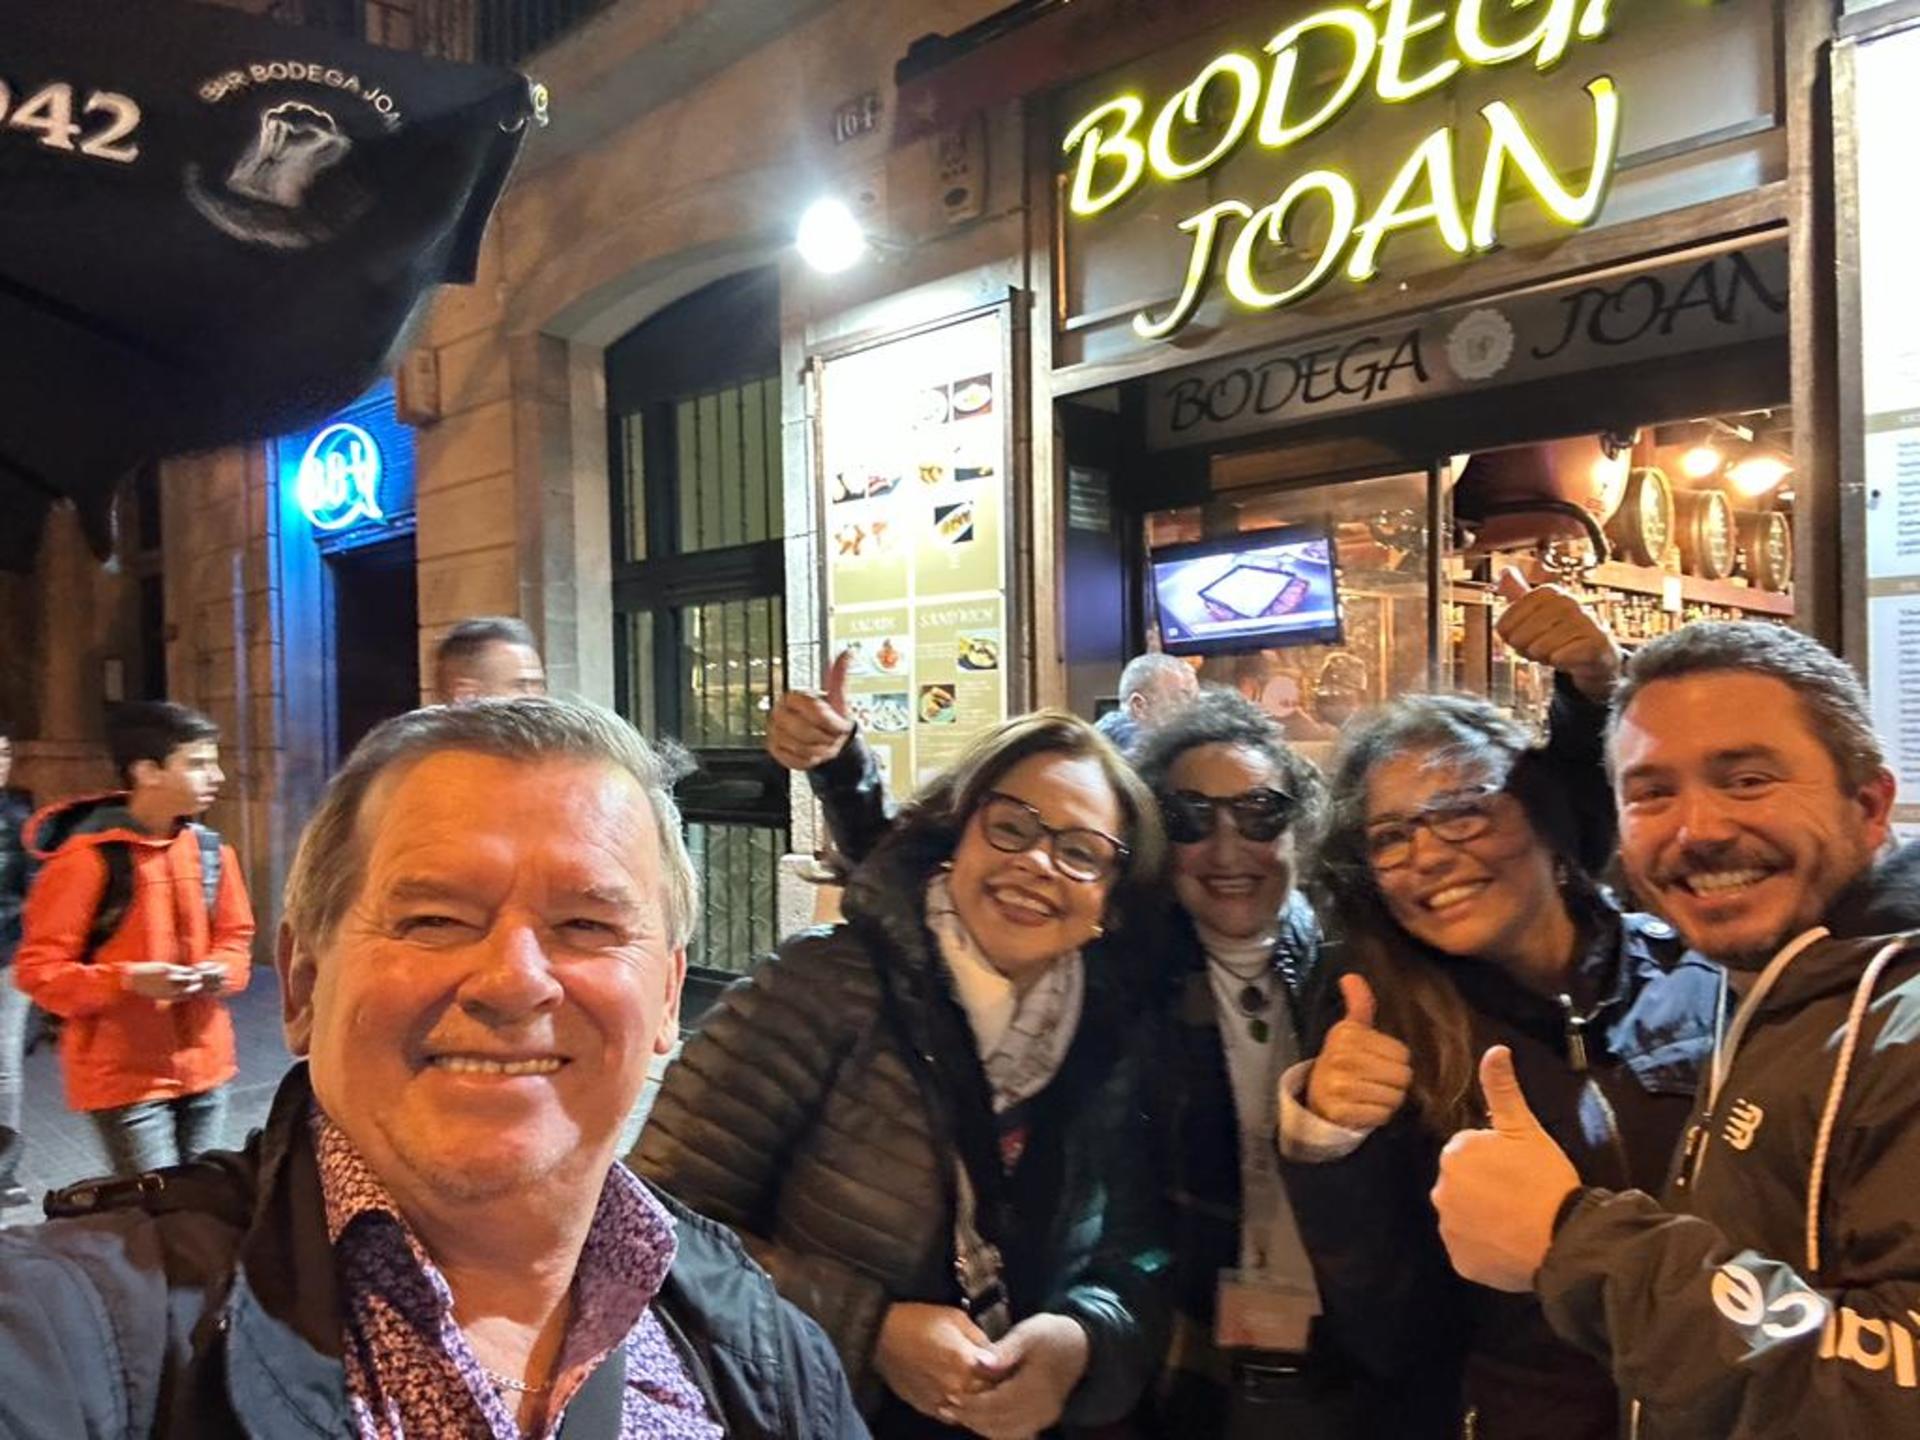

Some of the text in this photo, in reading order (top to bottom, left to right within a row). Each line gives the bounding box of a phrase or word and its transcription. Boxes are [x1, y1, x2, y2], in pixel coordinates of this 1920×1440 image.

[0, 80, 141, 164] 42
[249, 61, 361, 92] BODEGA
[1132, 75, 1624, 341] JOAN
[1168, 328, 1429, 432] BODEGA
